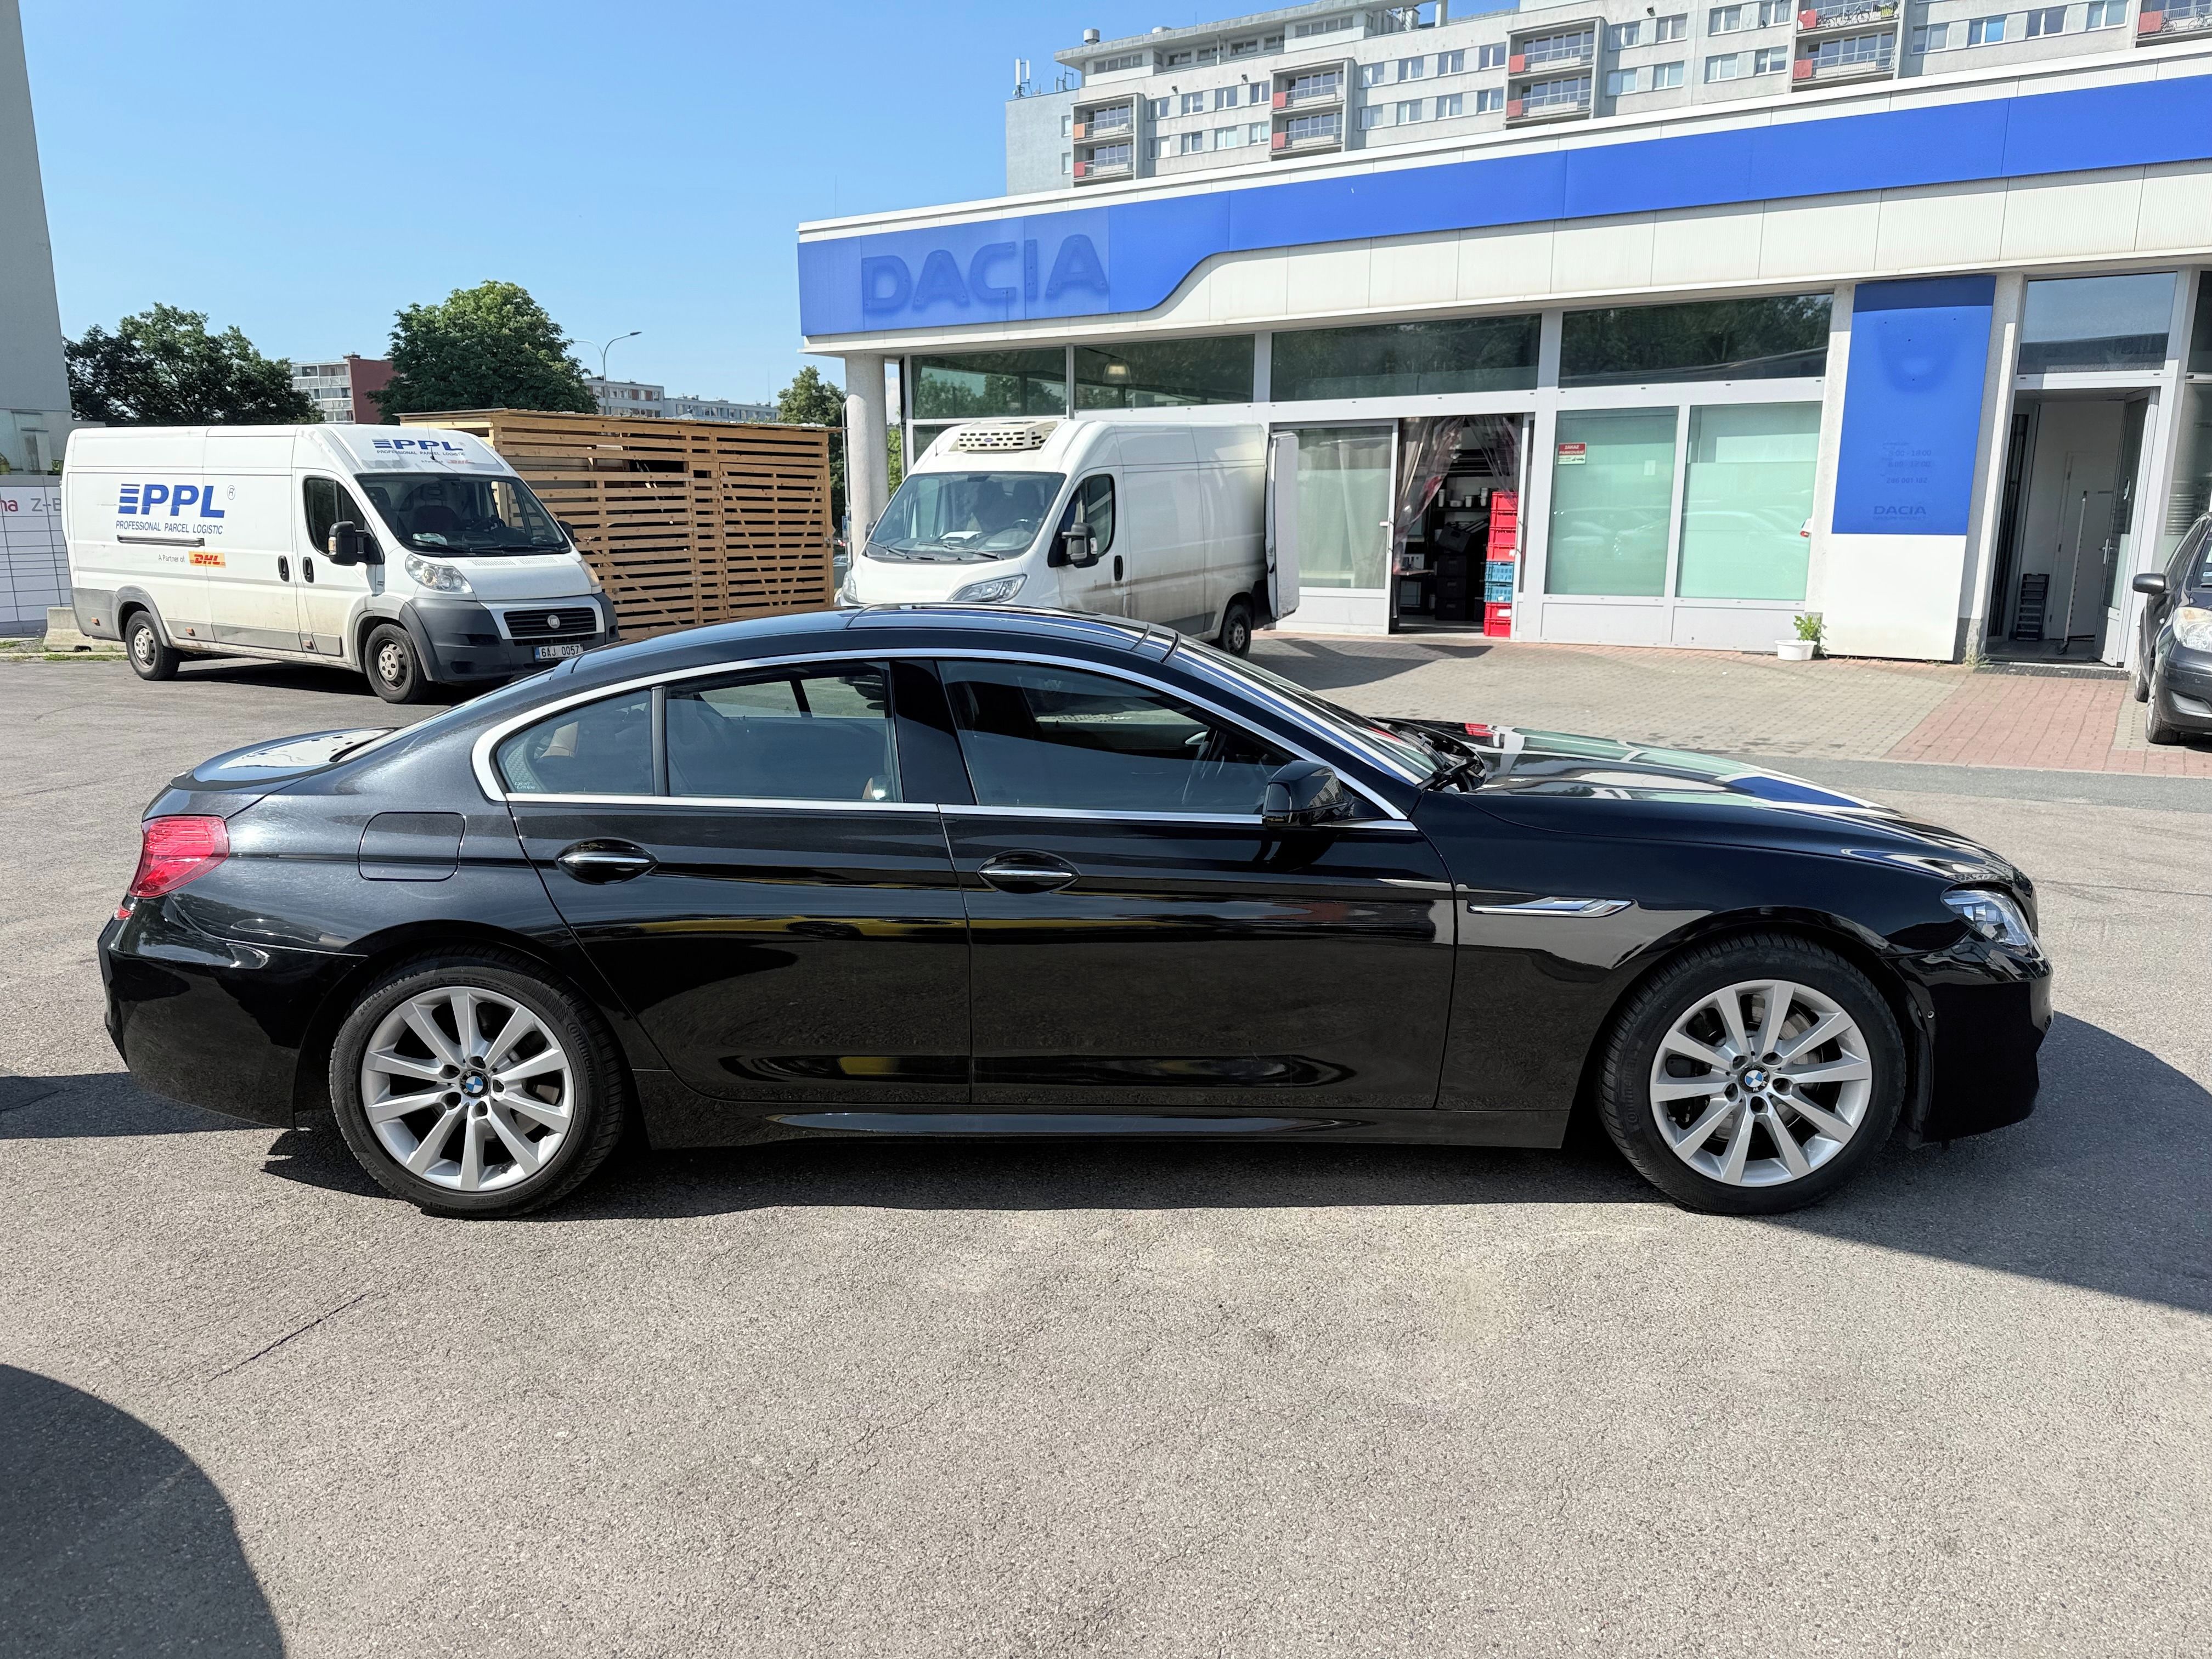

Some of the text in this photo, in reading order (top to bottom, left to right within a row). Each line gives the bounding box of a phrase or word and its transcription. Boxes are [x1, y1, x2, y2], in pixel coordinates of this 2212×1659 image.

[861, 234, 1109, 314] DACIA
[392, 439, 463, 450] PPL
[141, 484, 225, 518] PPL
[1874, 506, 1927, 515] DACIA
[116, 520, 223, 535] PROFESSIONAL PARCEL LOGISTIC
[194, 554, 220, 565] DHL
[541, 645, 579, 657] 6AJ 0057
